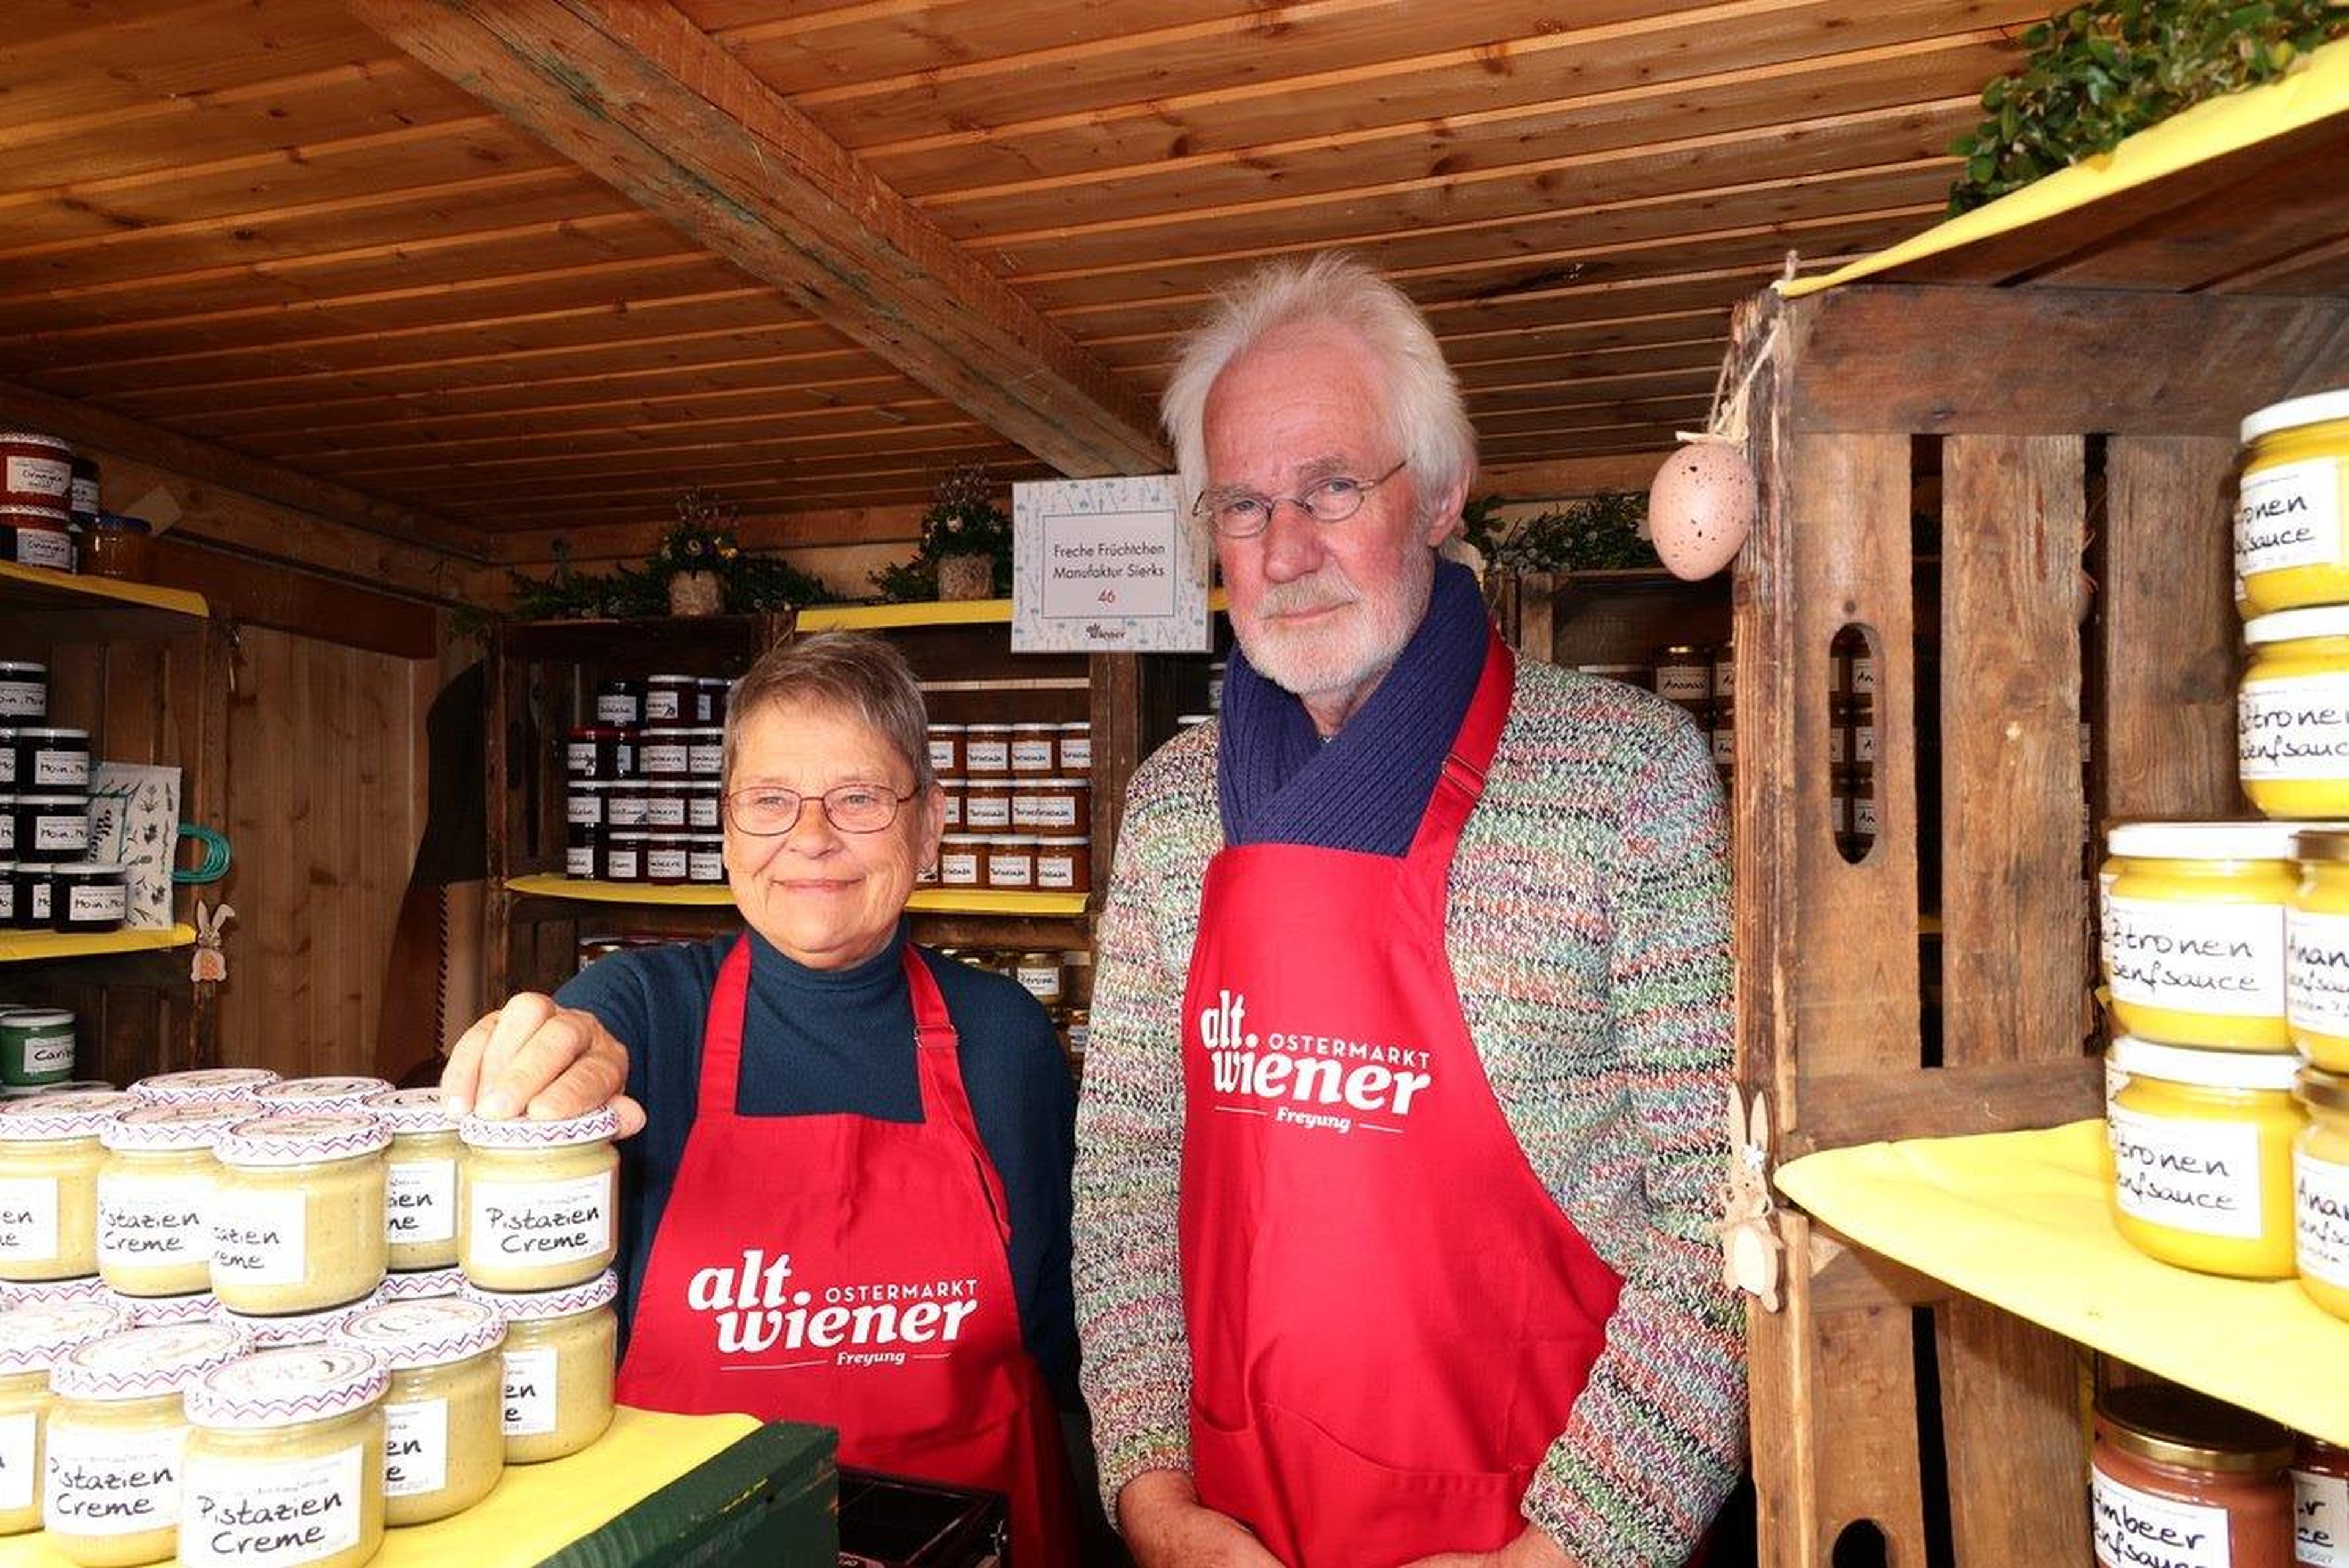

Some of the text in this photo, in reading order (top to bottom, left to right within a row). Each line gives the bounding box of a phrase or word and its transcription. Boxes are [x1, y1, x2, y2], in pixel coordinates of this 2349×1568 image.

[1054, 541, 1165, 558] Freche Früchtchen
[1053, 563, 1165, 579] Manufaktur Sierks
[1097, 589, 1116, 604] 46
[1268, 1033, 1430, 1069] OSTERMARKT
[1211, 1034, 1431, 1115] wiener
[1275, 1105, 1353, 1134] Freyung
[485, 1206, 599, 1230] Pistazien
[501, 1232, 589, 1254] Creme
[825, 1279, 978, 1304] OSTERMARKT
[716, 1290, 978, 1354] wiener
[837, 1351, 907, 1366] Freyung
[57, 1492, 155, 1518] Creme
[197, 1492, 343, 1525] Pistazien
[211, 1526, 326, 1555] Creme
